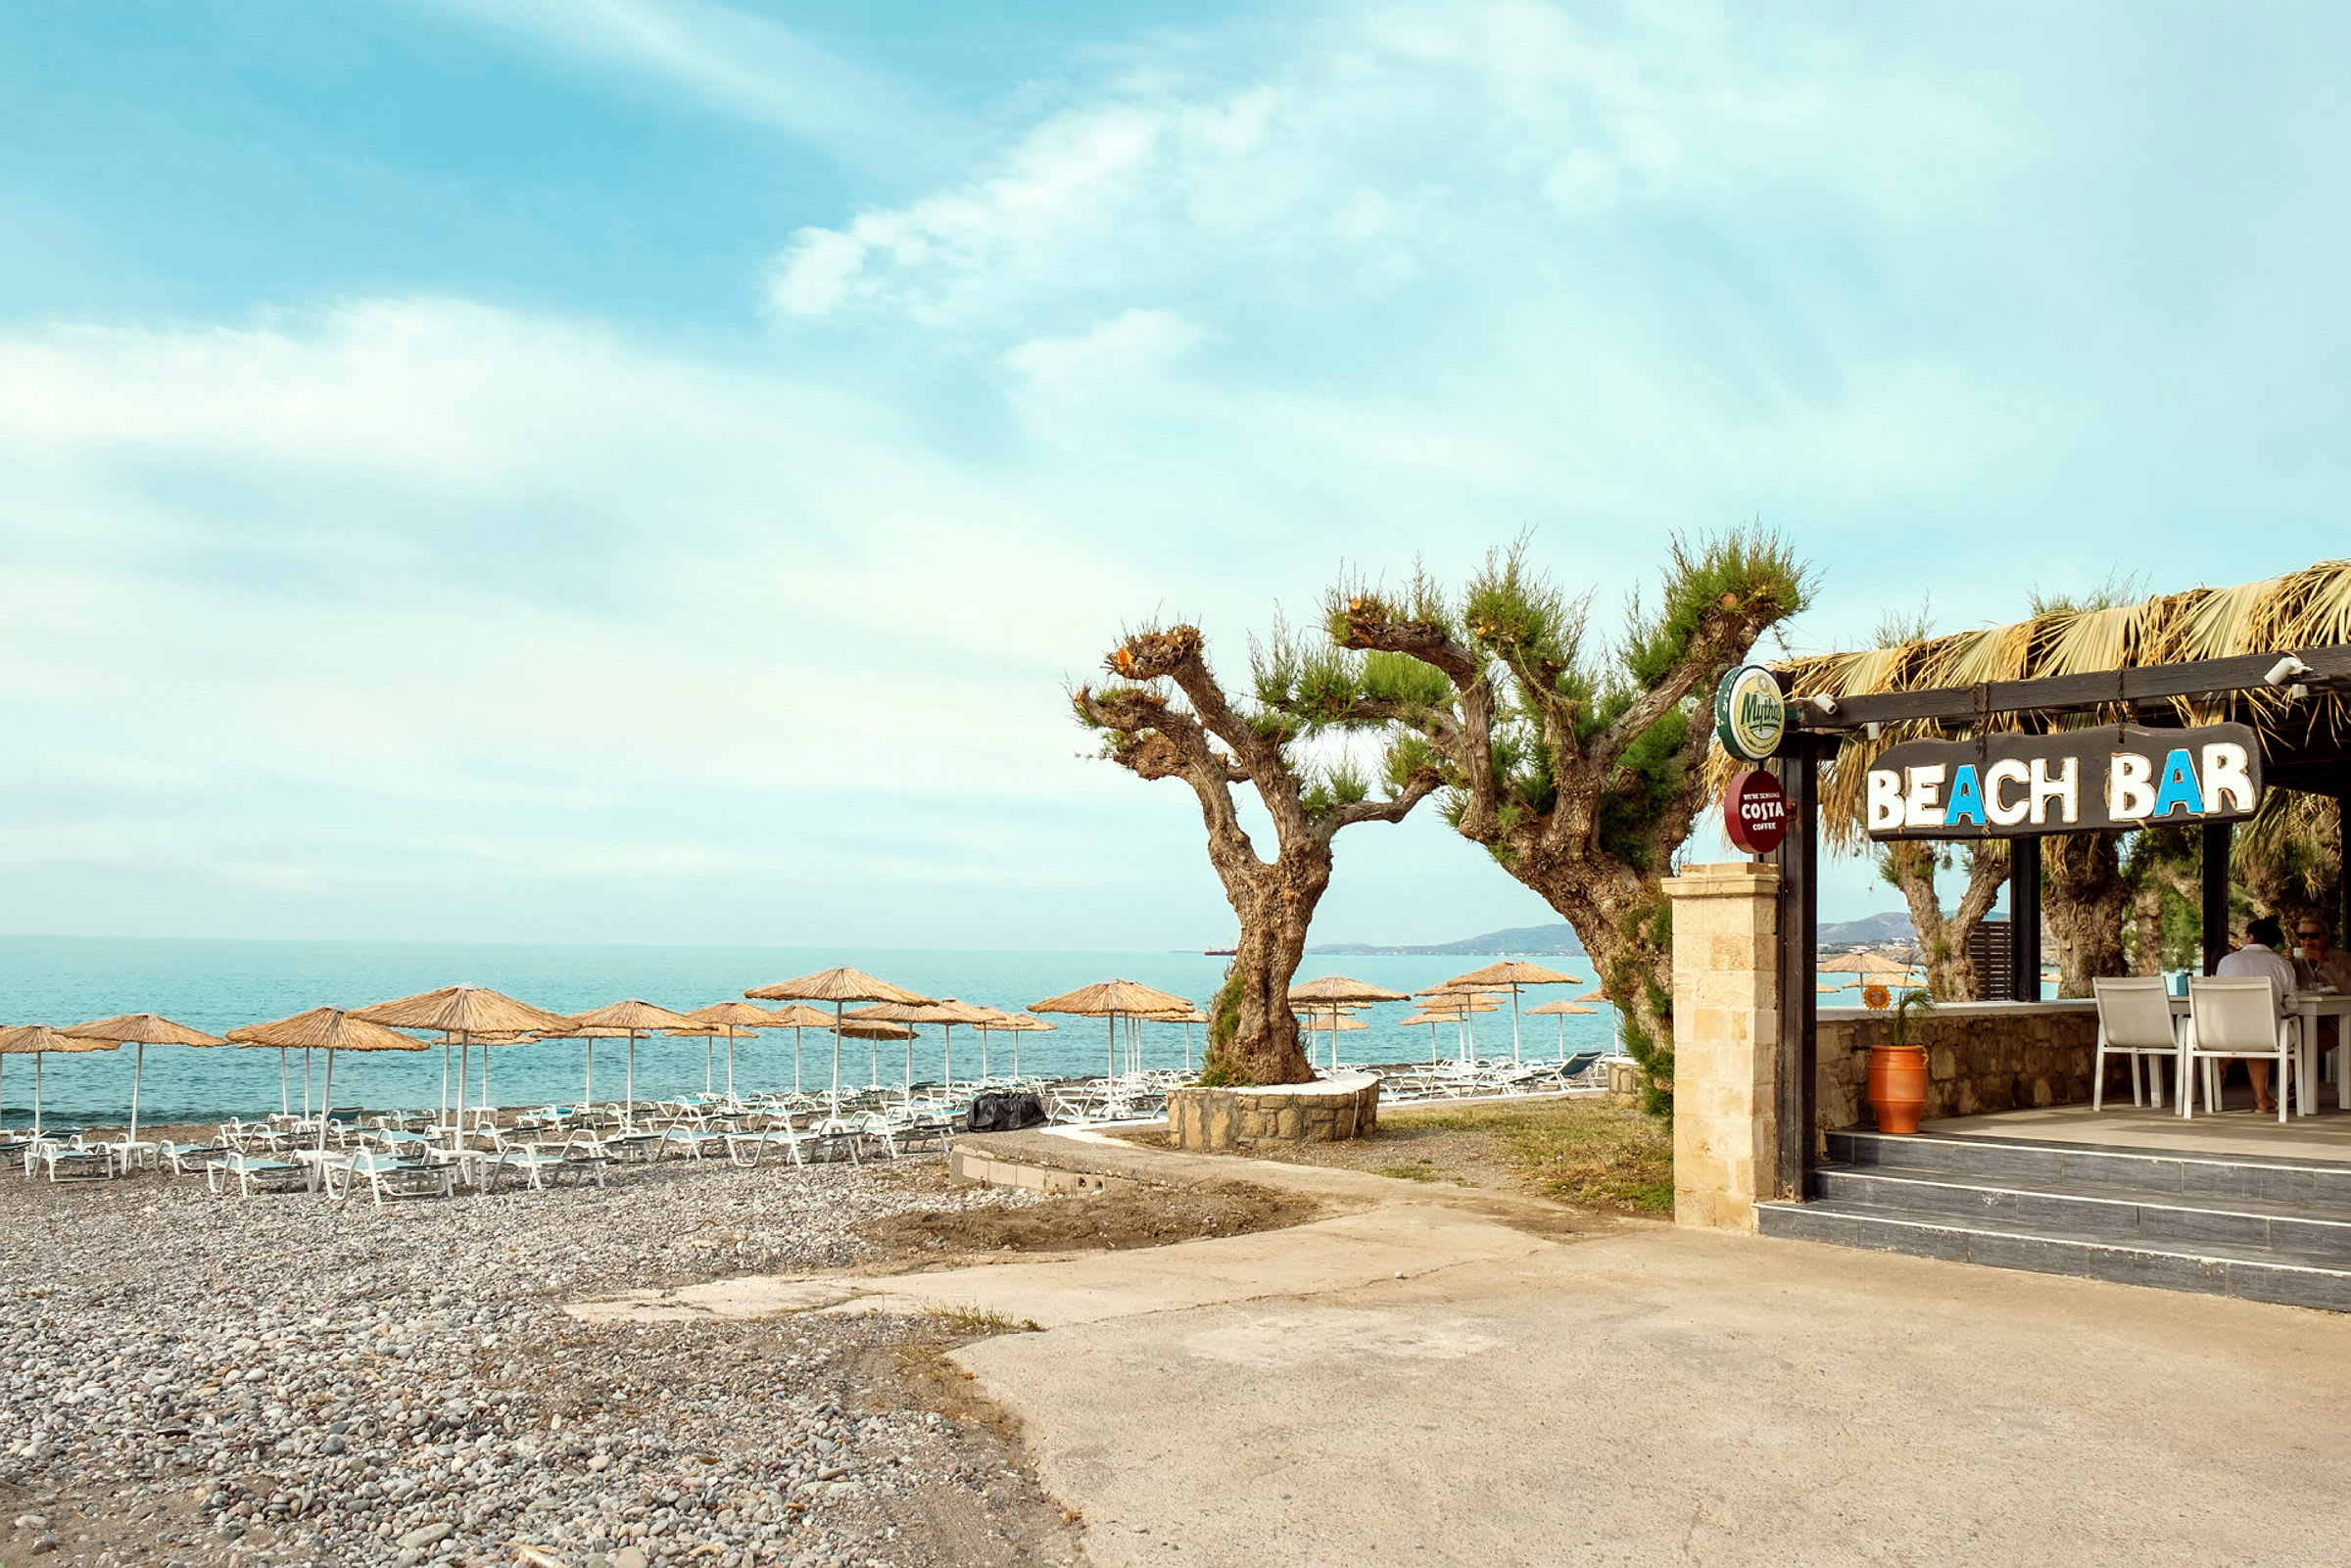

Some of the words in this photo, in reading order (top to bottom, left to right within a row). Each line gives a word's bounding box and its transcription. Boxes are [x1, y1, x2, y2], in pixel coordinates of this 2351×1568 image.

[1867, 756, 2079, 831] BEACH
[2109, 742, 2255, 822] BAR
[1741, 801, 1785, 821] COSTA
[1752, 822, 1777, 832] COFFEE
